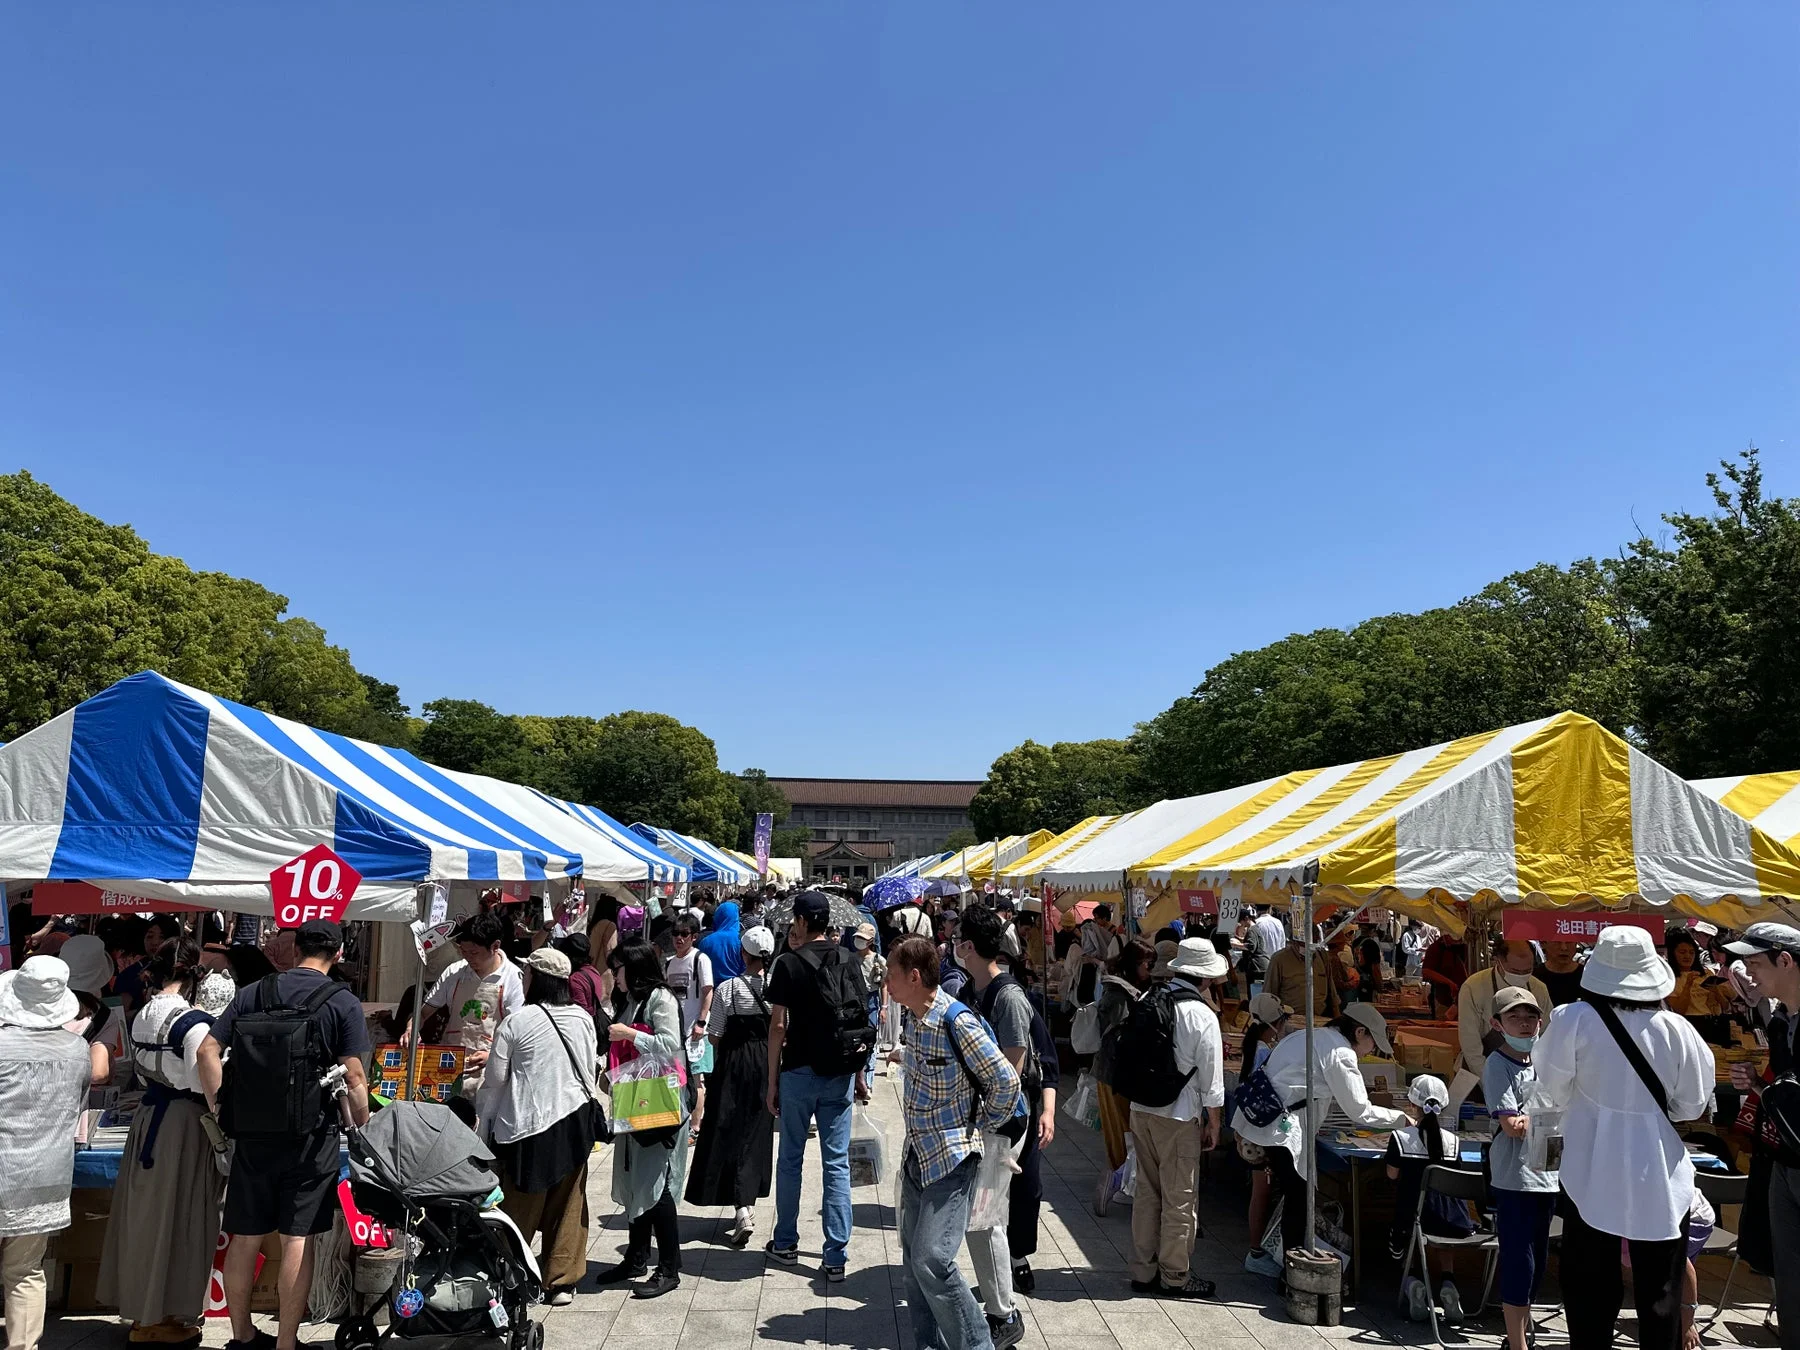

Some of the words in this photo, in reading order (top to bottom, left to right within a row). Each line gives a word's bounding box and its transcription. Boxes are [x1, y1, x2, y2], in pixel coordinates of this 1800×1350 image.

[281, 904, 334, 923] OFF
[1221, 898, 1239, 920] 33
[354, 1221, 392, 1241] OF
